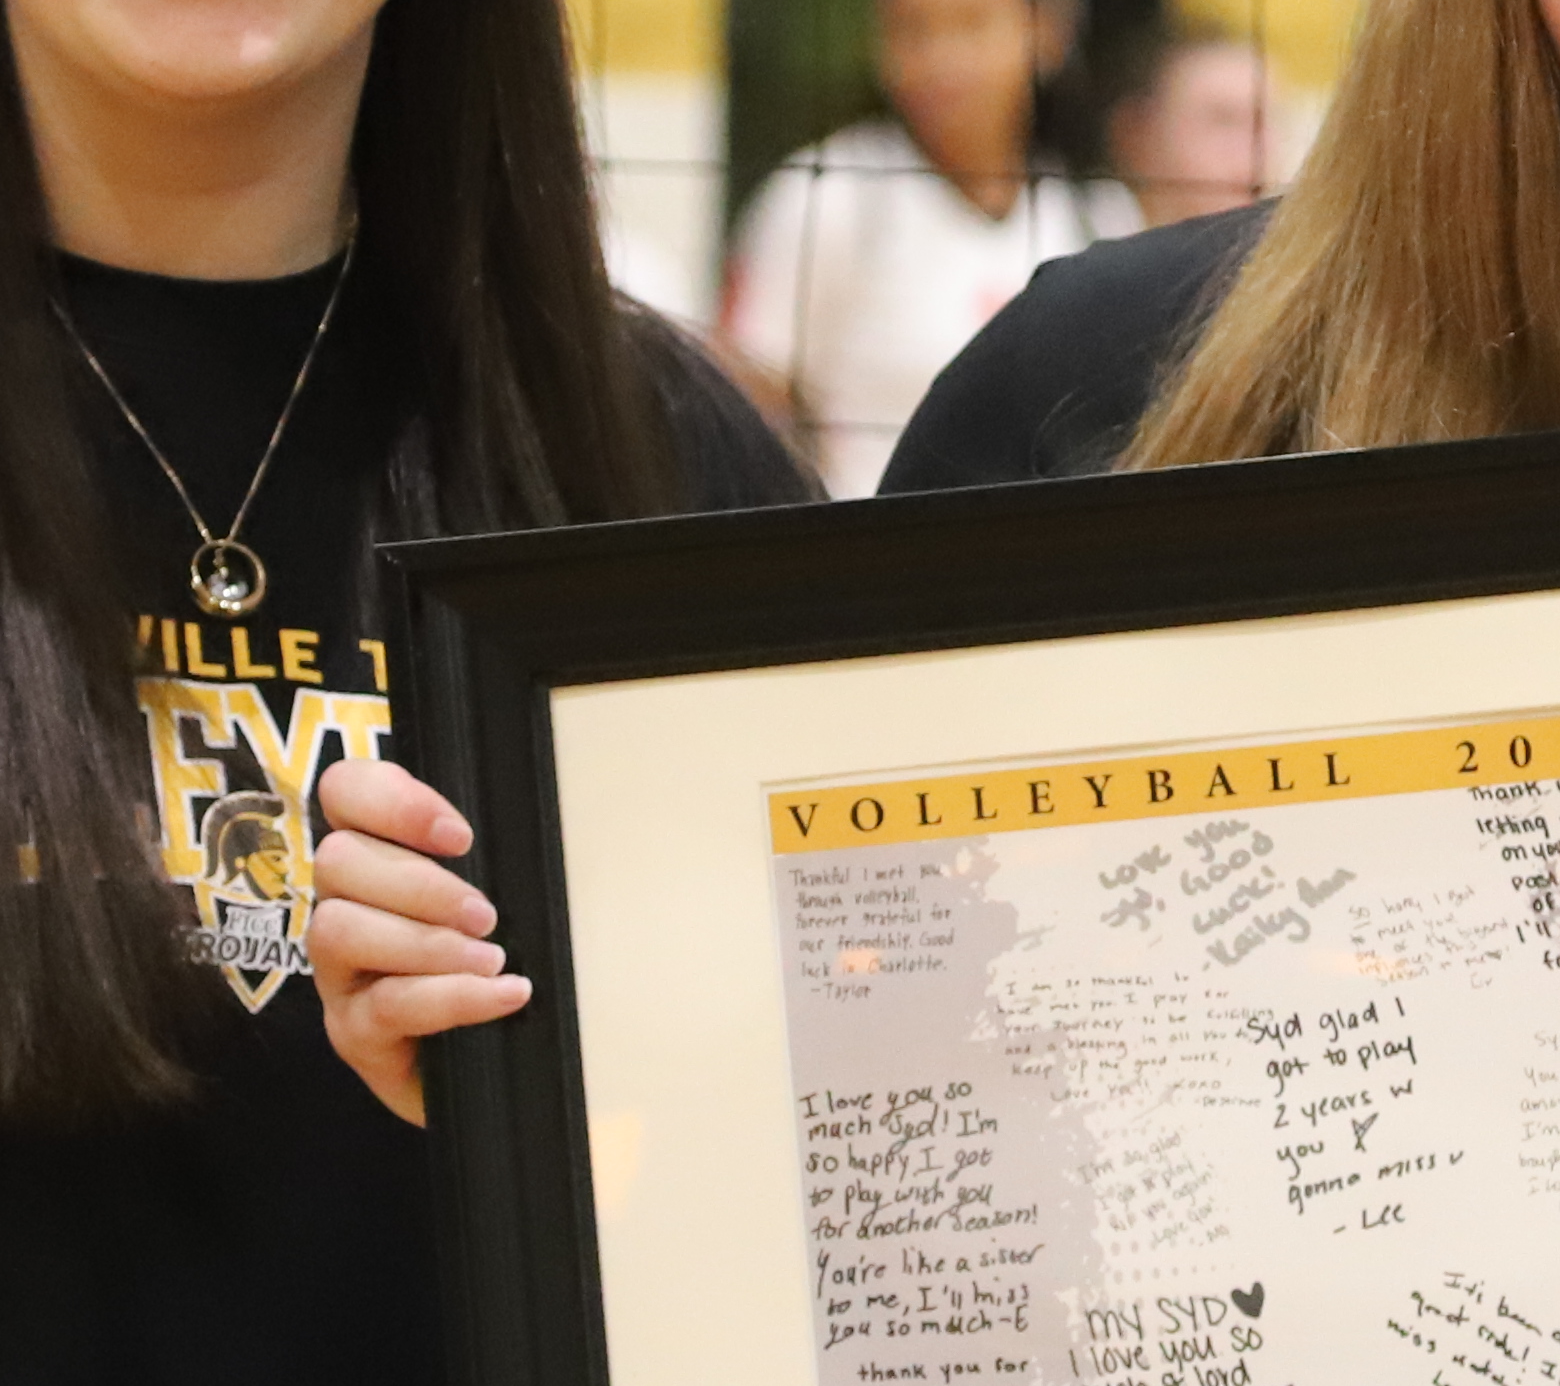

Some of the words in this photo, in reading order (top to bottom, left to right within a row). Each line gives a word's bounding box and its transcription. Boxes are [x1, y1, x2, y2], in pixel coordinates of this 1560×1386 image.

[788, 752, 1351, 839] VOLLEYBALL
[1477, 815, 1548, 837] letting
[1502, 846, 1526, 861] on
[1533, 893, 1554, 912] of
[1247, 1013, 1303, 1051] Syd
[1320, 1001, 1378, 1042] glad
[1267, 1057, 1309, 1097] got
[1324, 1048, 1347, 1065] to
[1358, 1036, 1416, 1070] play
[800, 1093, 817, 1117] I
[828, 1090, 873, 1113] love
[945, 1082, 972, 1099] so
[1274, 1105, 1289, 1129] 2
[1301, 1091, 1371, 1127] years
[809, 1116, 871, 1140] much
[956, 1109, 998, 1136] I'm
[806, 1153, 838, 1173] so
[848, 1144, 908, 1182] happy
[914, 1147, 943, 1176] I
[946, 1149, 991, 1182] got
[1277, 1141, 1324, 1181] you
[809, 1188, 833, 1207] to
[846, 1180, 890, 1221] play
[895, 1177, 944, 1205] with
[942, 1184, 992, 1218] you
[1289, 1174, 1360, 1215] gonna
[1378, 1154, 1435, 1179] miss
[812, 1217, 849, 1240] for
[857, 1209, 945, 1239] another
[951, 1205, 1037, 1232] season!
[903, 1246, 944, 1274] like
[956, 1257, 971, 1273] a
[981, 1238, 1044, 1266] sister
[828, 1298, 850, 1315] to
[867, 1297, 909, 1315] me,
[917, 1285, 962, 1313] I'll
[974, 1278, 1028, 1306] miss
[1158, 1296, 1227, 1333] SYD
[825, 1321, 870, 1349] you
[887, 1321, 909, 1337] so
[922, 1311, 991, 1334] much
[858, 1363, 927, 1382] thank
[940, 1363, 980, 1383] you
[996, 1358, 1028, 1373] for
[1069, 1349, 1079, 1377] I
[1091, 1347, 1150, 1376] love
[1160, 1336, 1216, 1371] you
